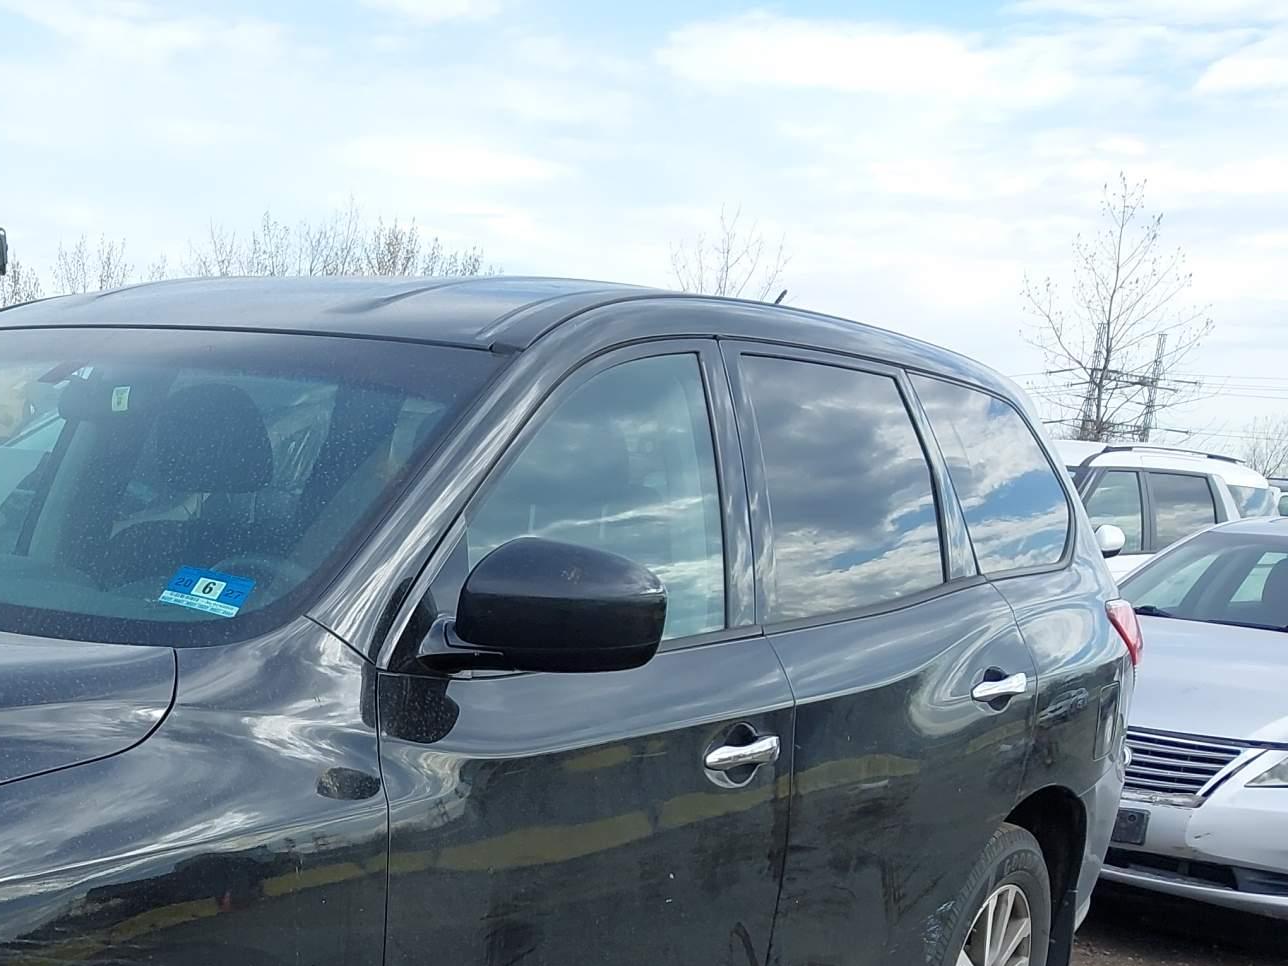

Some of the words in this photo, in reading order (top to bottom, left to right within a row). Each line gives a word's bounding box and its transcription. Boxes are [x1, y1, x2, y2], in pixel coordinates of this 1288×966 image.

[175, 577, 193, 588] 20
[202, 581, 216, 595] 6
[223, 588, 243, 600] 27
